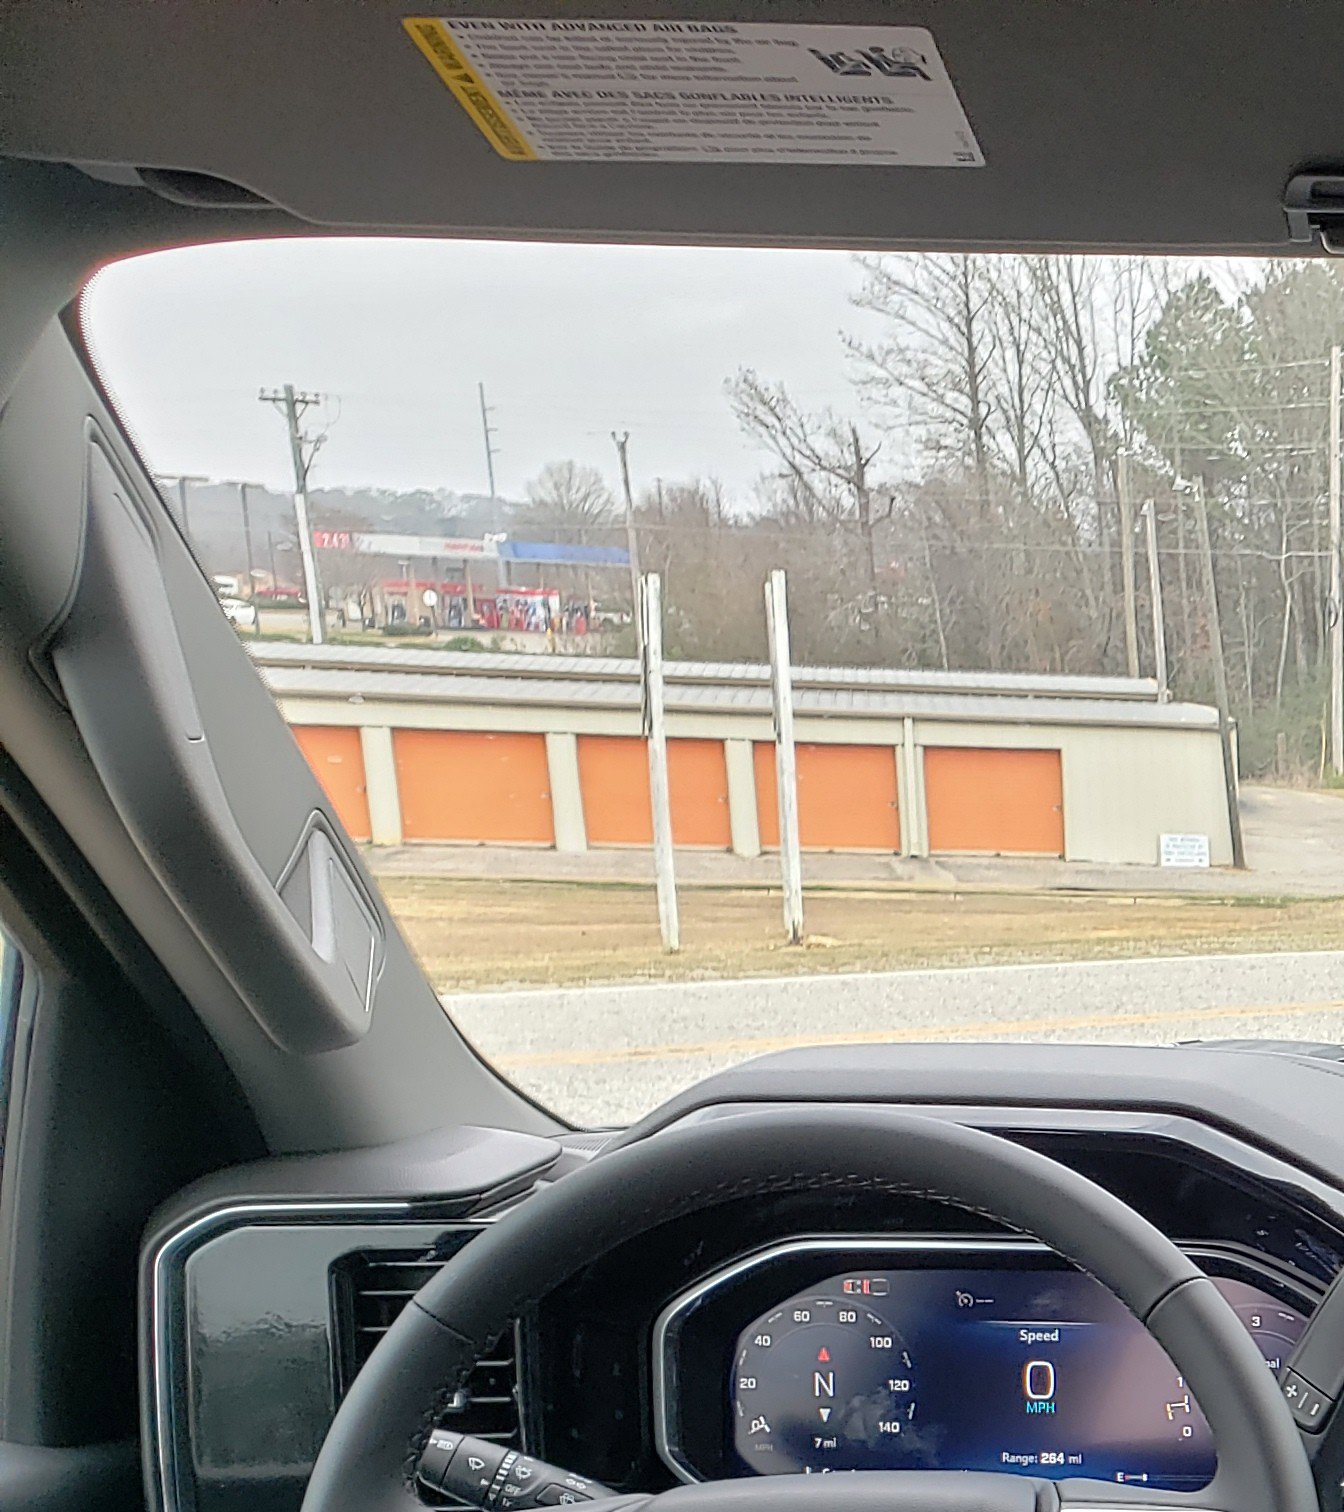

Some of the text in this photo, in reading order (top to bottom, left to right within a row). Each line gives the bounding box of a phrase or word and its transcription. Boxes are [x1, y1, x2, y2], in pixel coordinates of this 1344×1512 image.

[794, 1312, 810, 1322] 60
[839, 1312, 856, 1322] 80
[1251, 1316, 1261, 1327] 3
[755, 1336, 771, 1346] 40
[1020, 1329, 1060, 1343] Speed
[870, 1337, 892, 1348] 100
[740, 1378, 756, 1389] 20
[814, 1372, 834, 1397] N
[888, 1380, 909, 1391] 120
[1023, 1361, 1055, 1400] 0
[1177, 1377, 1184, 1387] 1
[1026, 1402, 1055, 1414] MPH
[879, 1422, 900, 1433] 140
[1183, 1426, 1192, 1437] 0
[815, 1438, 837, 1448] 7 mi
[1003, 1453, 1082, 1465] Range: 264 mi
[1117, 1473, 1125, 1482] E
